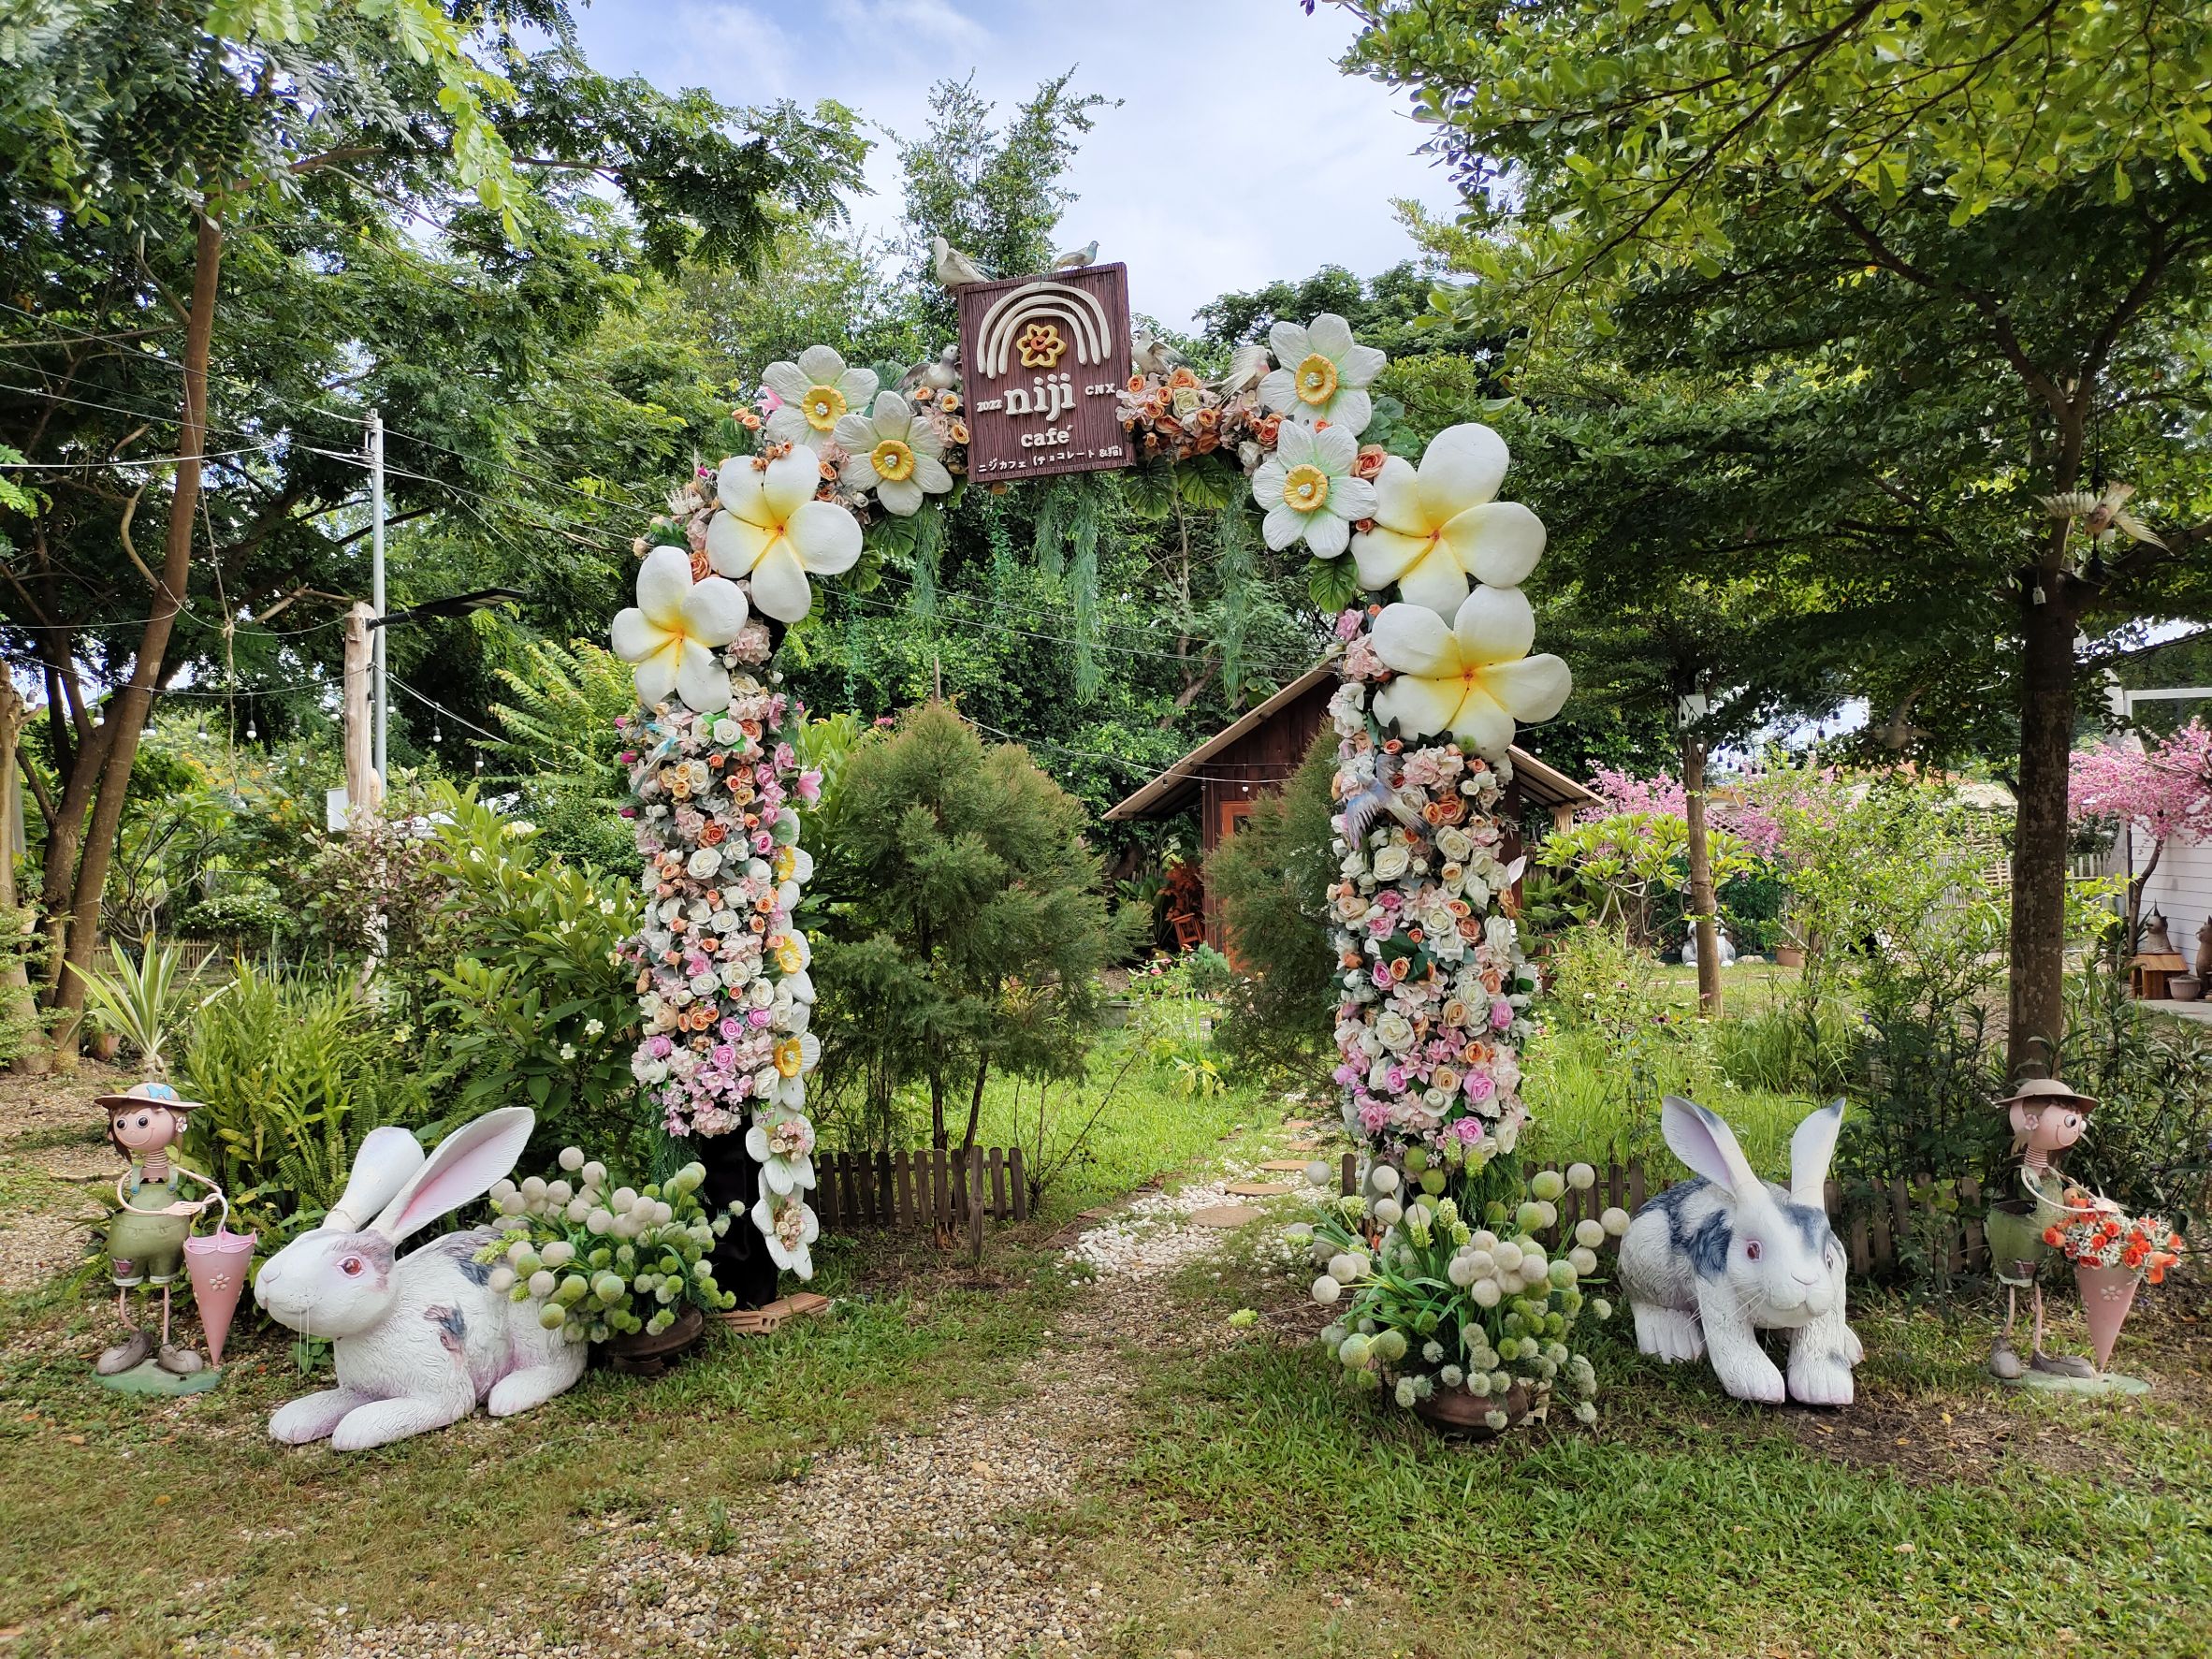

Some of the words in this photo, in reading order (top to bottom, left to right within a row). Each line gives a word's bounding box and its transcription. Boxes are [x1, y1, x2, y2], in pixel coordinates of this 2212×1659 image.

[976, 399, 1003, 413] 2022
[1004, 372, 1076, 422] niji
[1084, 383, 1116, 396] CNX
[1021, 425, 1073, 448] café
[978, 458, 1026, 473] ニジカフェ
